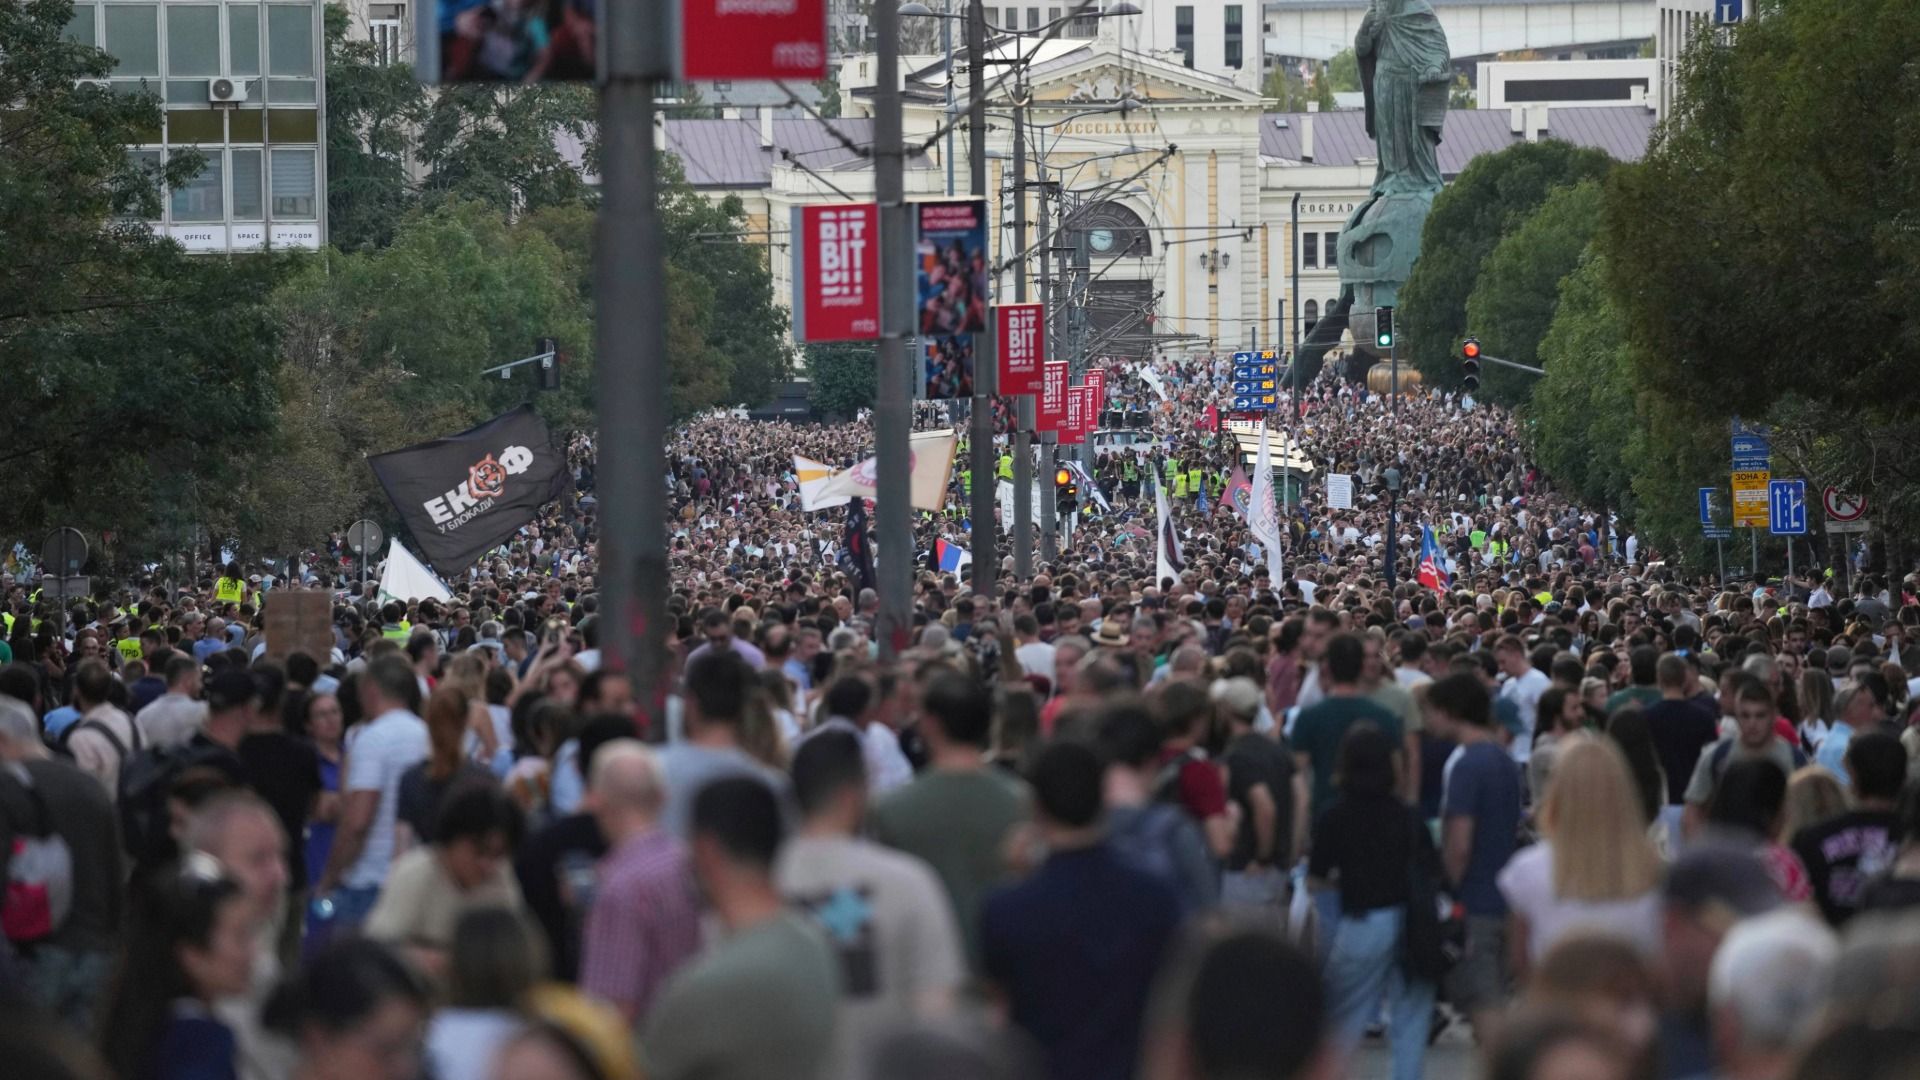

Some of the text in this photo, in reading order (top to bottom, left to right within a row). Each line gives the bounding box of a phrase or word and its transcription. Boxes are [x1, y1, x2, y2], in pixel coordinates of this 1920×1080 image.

[1300, 204, 1353, 213] EOGRAD
[851, 319, 876, 333] mts
[1735, 472, 1768, 481] ЗОНА 2
[438, 496, 495, 534] У БЛОКАДИ
